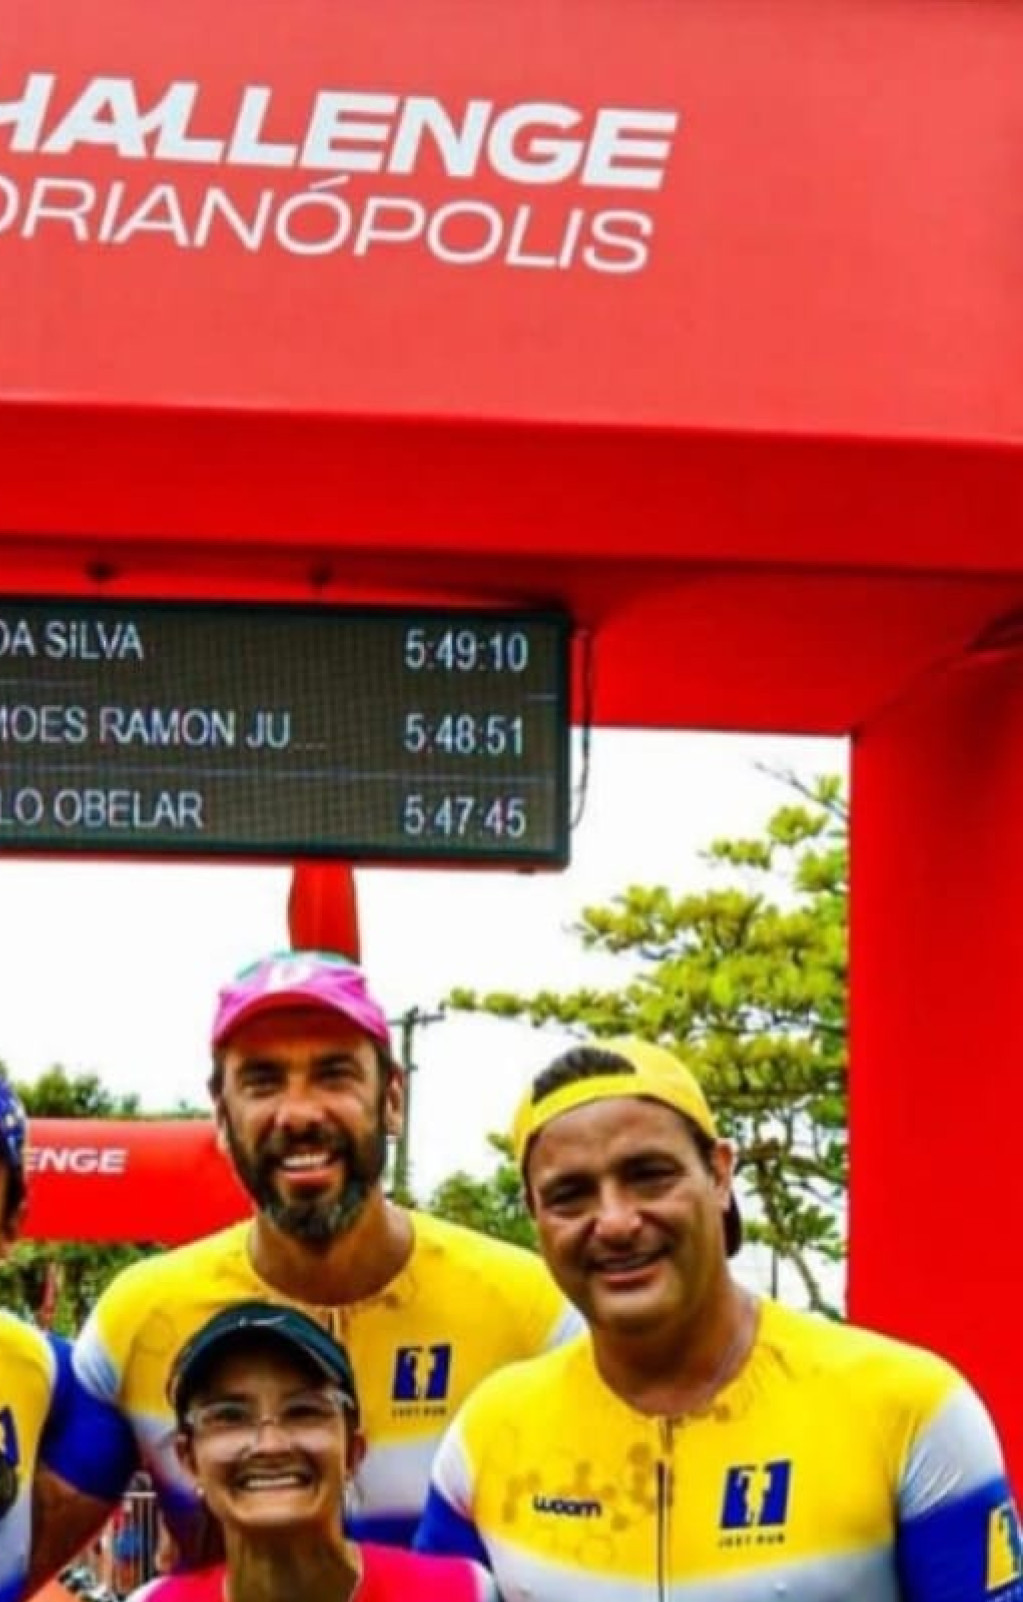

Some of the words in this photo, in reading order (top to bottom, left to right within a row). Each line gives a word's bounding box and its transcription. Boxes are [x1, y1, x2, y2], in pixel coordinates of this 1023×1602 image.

[405, 630, 529, 673] 5:49:10
[99, 706, 236, 747] RAMON
[405, 714, 526, 756] 5:48:51
[54, 789, 204, 829] OBELAR
[405, 798, 528, 839] 5:47:45
